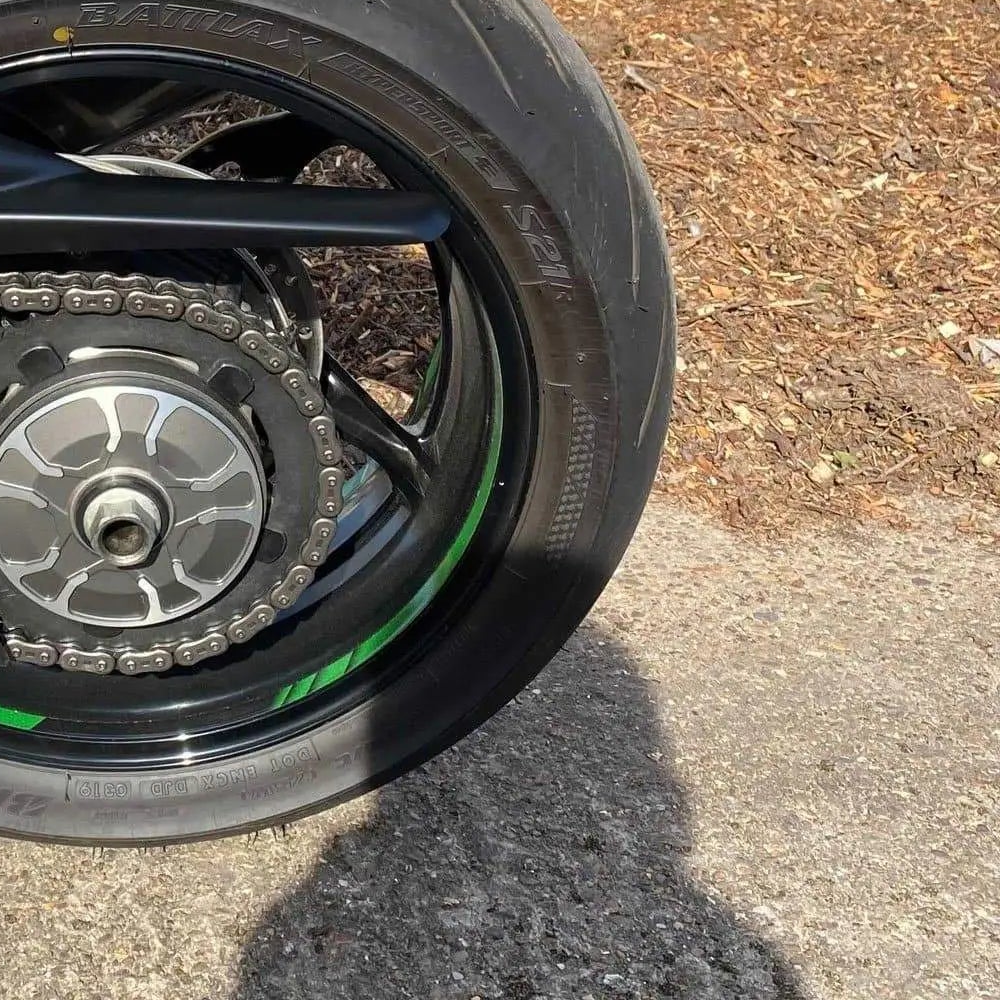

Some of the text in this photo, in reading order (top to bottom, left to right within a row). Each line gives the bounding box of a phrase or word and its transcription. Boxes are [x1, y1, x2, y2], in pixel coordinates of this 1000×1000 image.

[77, 2, 322, 58] BATTLAX
[270, 744, 313, 769] DOT
[78, 780, 128, 799] 0319
[150, 779, 187, 797] DJD
